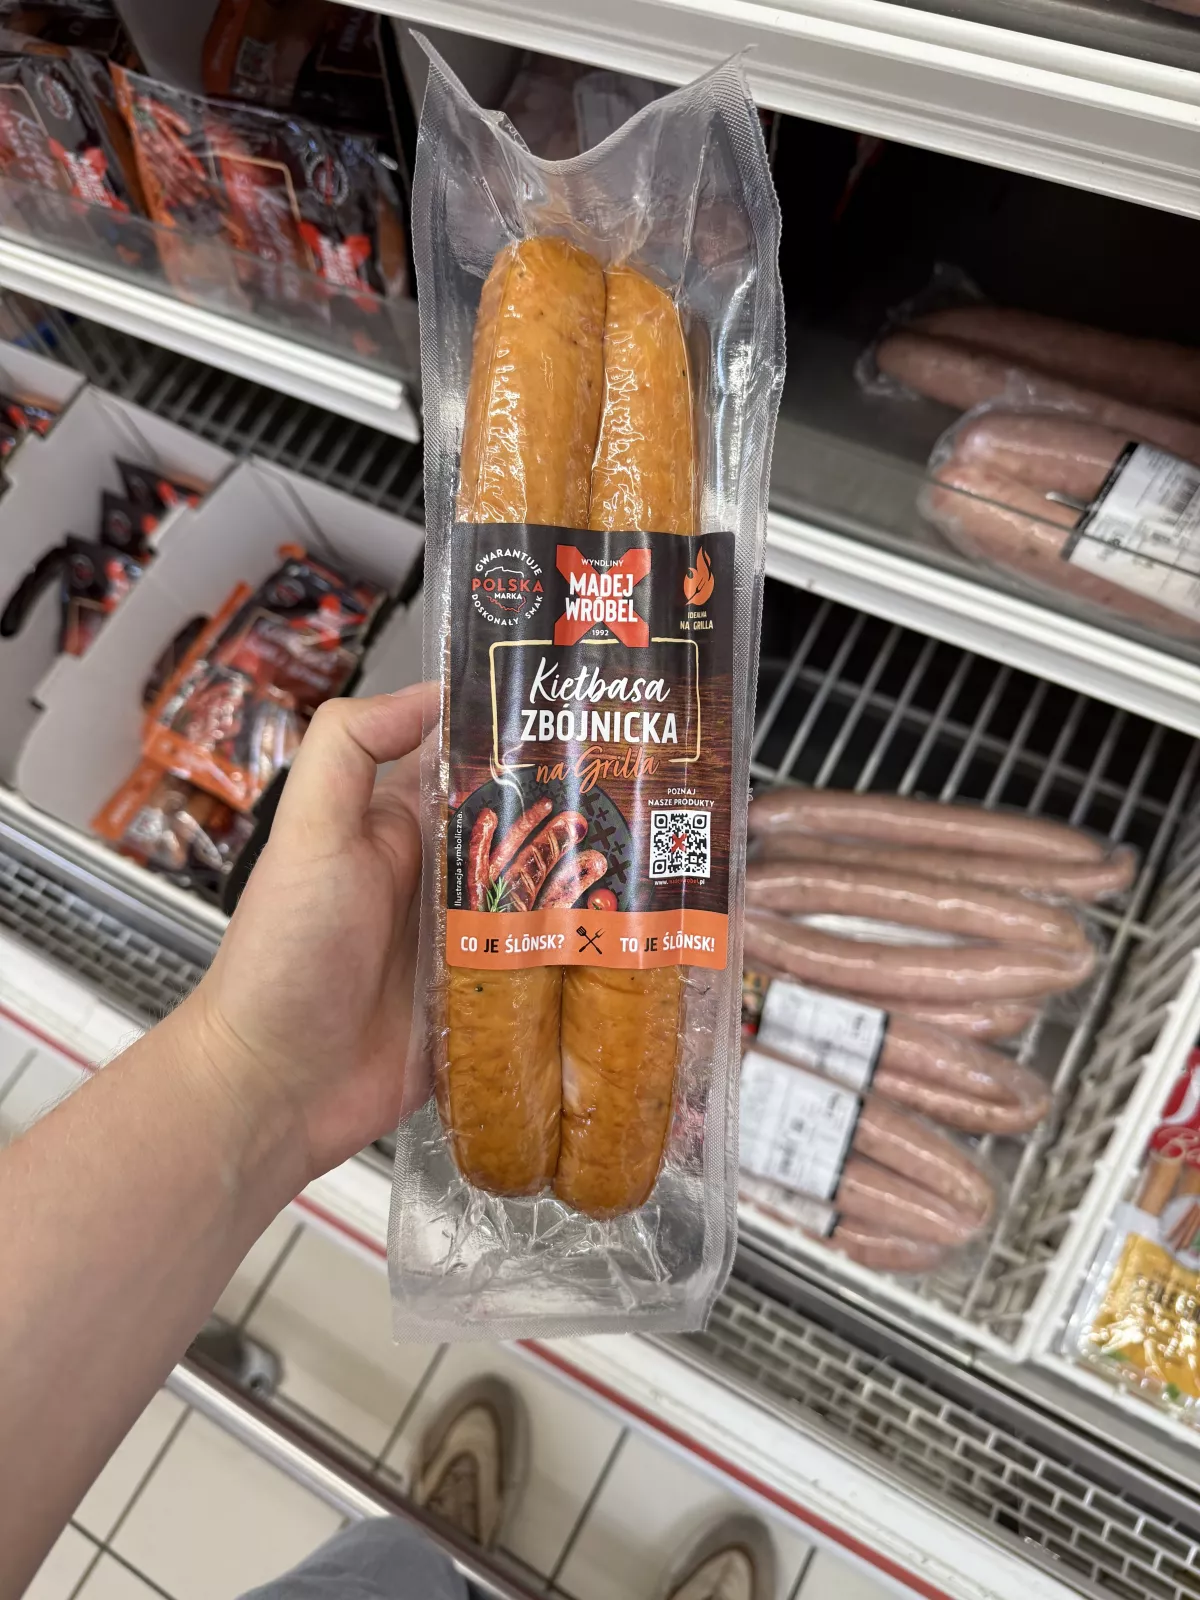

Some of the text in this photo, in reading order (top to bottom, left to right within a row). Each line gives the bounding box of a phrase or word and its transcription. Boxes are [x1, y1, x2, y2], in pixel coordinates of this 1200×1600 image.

[475, 548, 542, 576] GWARANTUJE
[581, 558, 624, 567] WYNDLINY
[471, 577, 545, 593] POLSKA
[569, 571, 634, 597] MADEJ
[494, 592, 523, 600] MARKA
[471, 593, 543, 626] DOSKONAŁY SMAK
[565, 596, 638, 623] WRÓBEL
[679, 619, 714, 630] NA GRILLA
[520, 703, 678, 744] ZBÓJNICKA
[535, 746, 660, 794] na Grilla
[648, 798, 715, 807] NASZE PRODUKTY
[454, 868, 463, 907] Ilustracja
[460, 936, 478, 953] CO
[484, 938, 499, 953] JE
[620, 936, 638, 953] TO
[644, 936, 658, 953] JE
